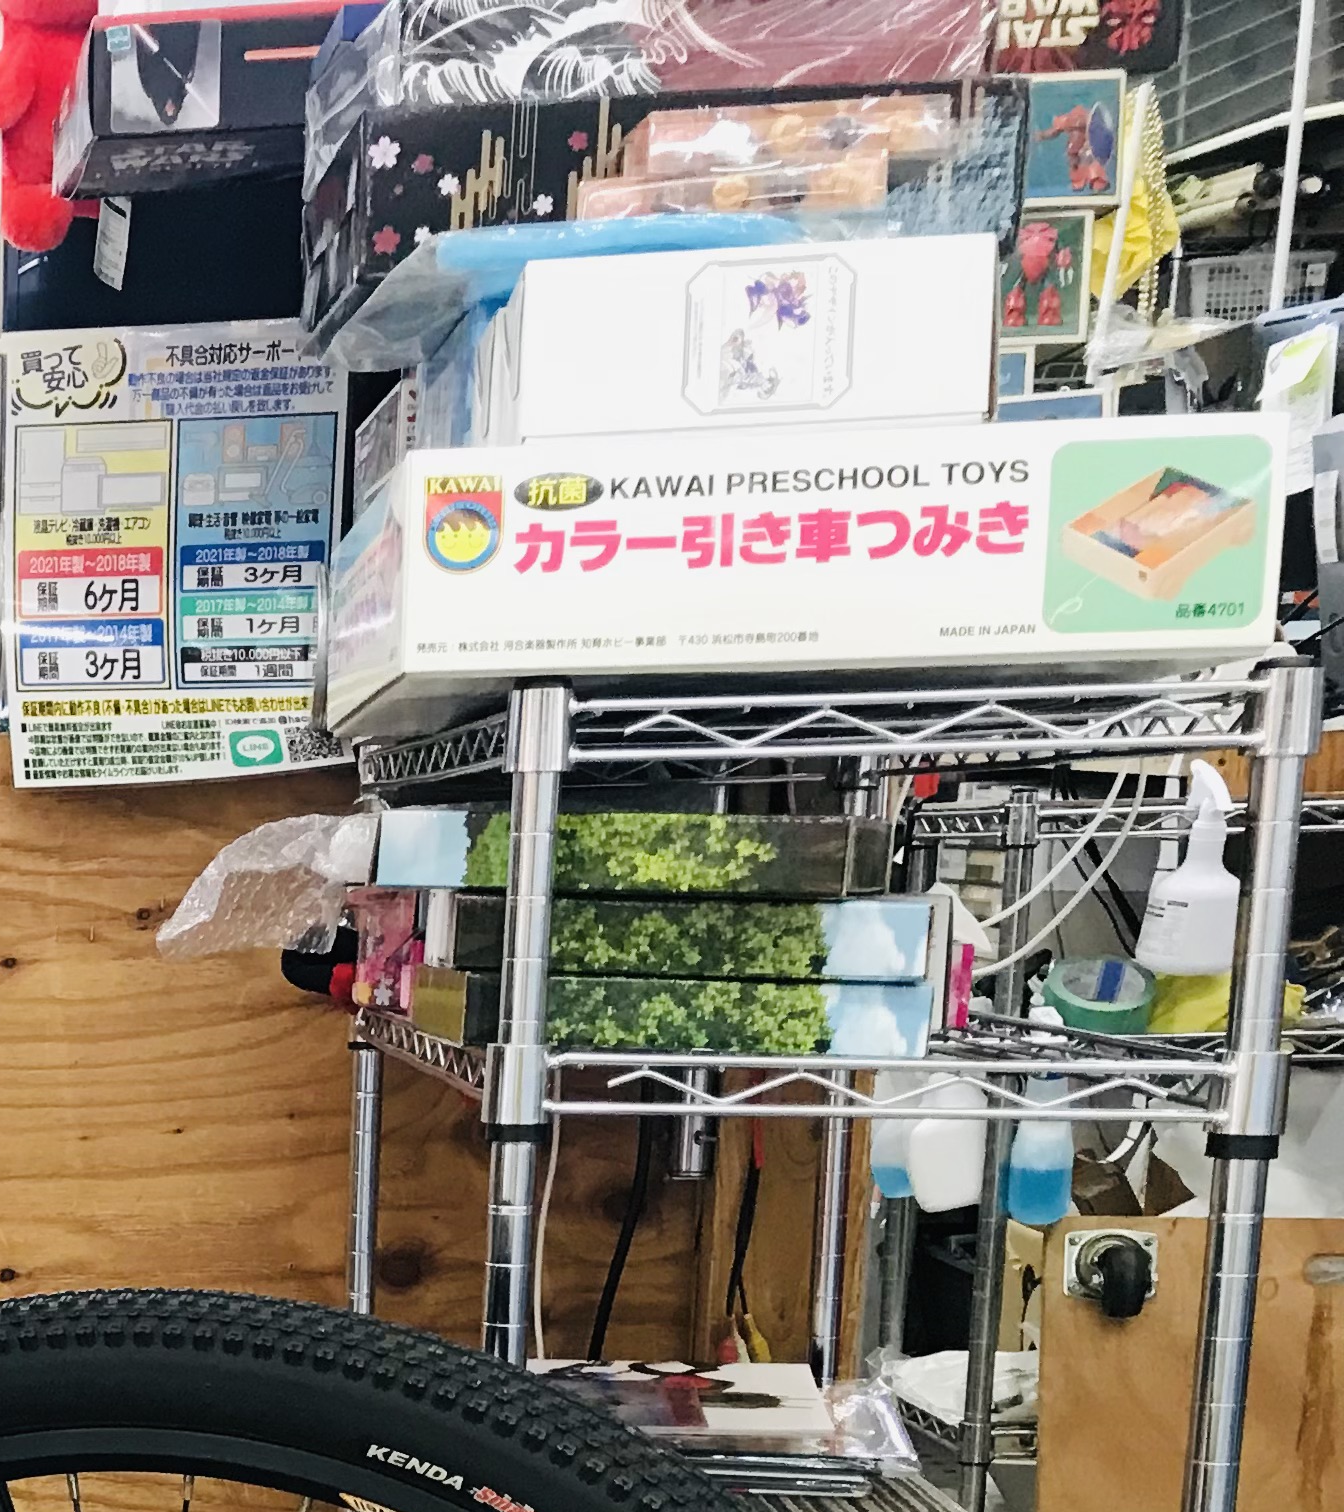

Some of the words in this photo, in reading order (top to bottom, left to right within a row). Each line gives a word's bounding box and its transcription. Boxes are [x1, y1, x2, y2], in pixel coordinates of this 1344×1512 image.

[21, 344, 83, 374] 買って
[43, 370, 89, 394] 安心
[428, 475, 503, 495] KAWAI
[528, 475, 588, 507] 抗菌
[611, 473, 715, 500] KAWAI
[726, 463, 930, 496] PRESCHOOL
[941, 459, 1030, 486] TOYS
[514, 500, 1030, 575] カラー引き車つみき
[939, 625, 975, 638] MADE
[978, 624, 991, 637] IN
[994, 623, 1036, 636] JAPAN
[366, 1443, 465, 1493] KENDA
